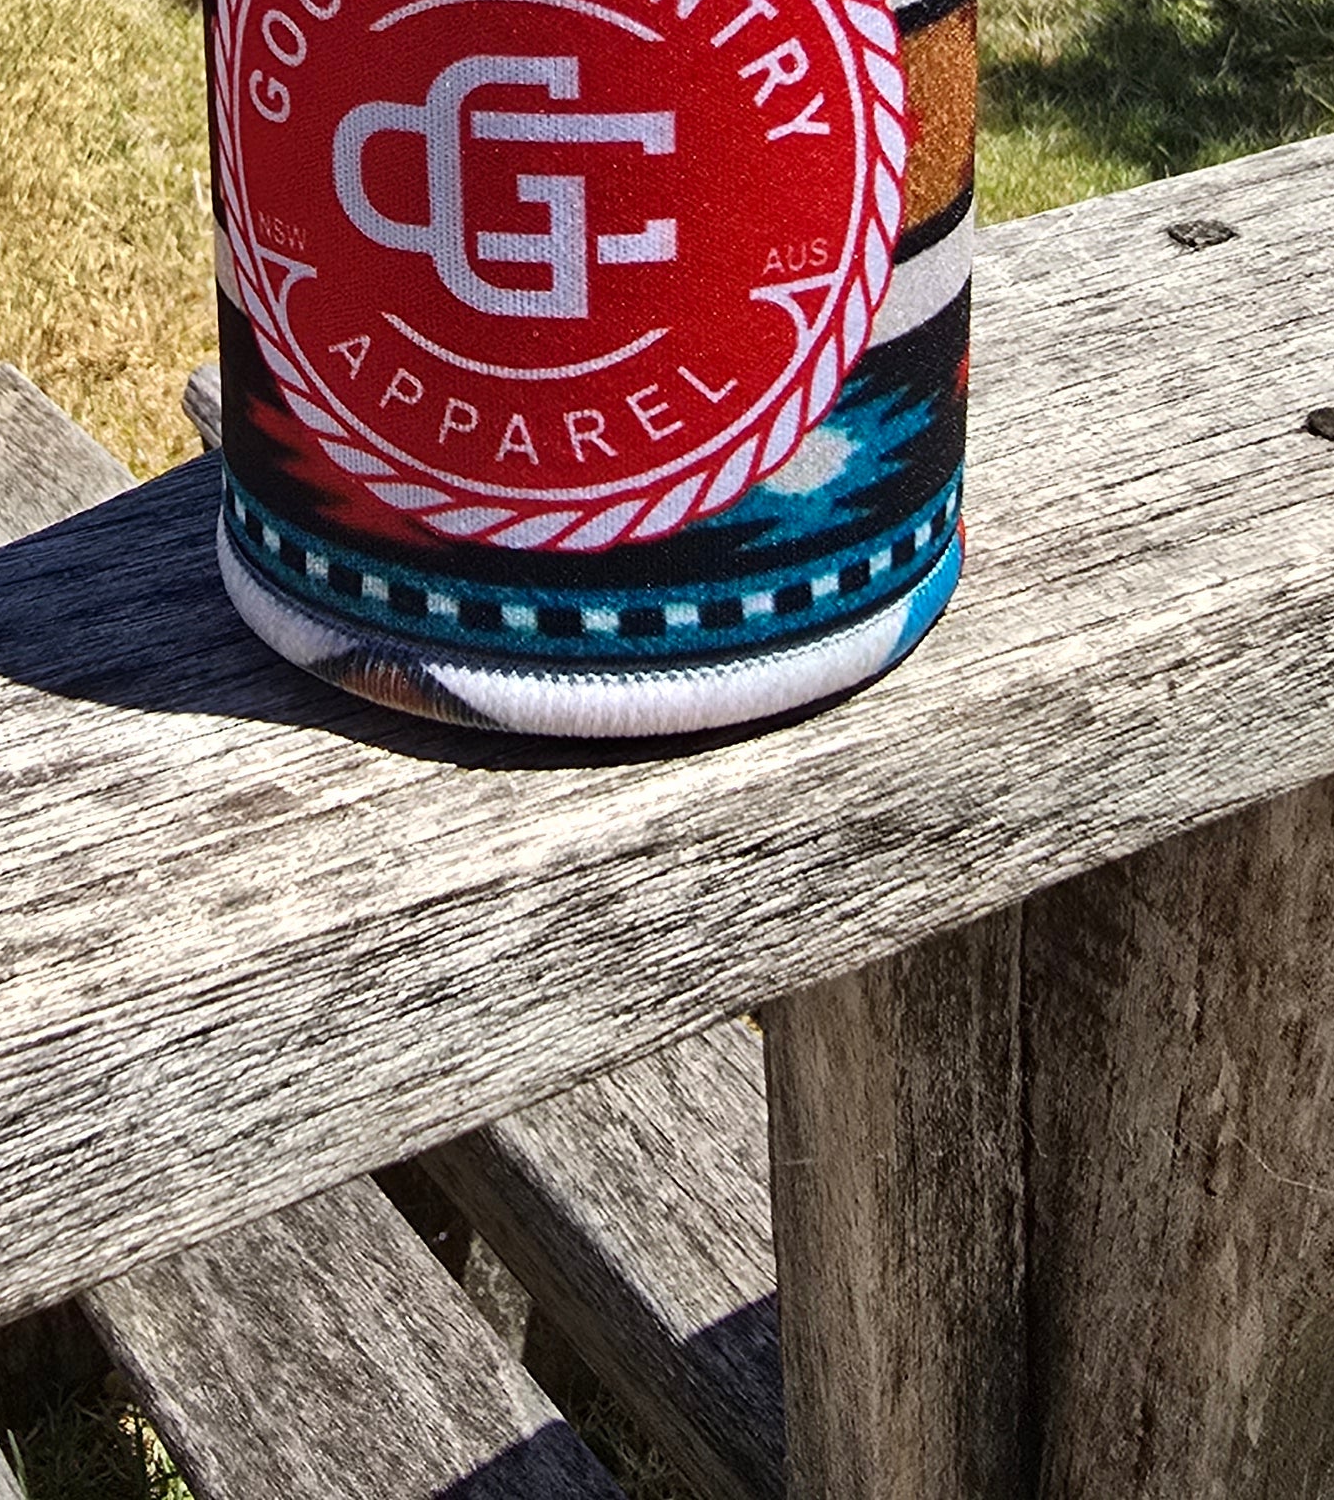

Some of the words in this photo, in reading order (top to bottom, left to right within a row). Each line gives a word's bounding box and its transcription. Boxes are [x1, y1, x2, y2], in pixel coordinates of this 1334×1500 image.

[257, 209, 307, 251] NSW
[761, 238, 829, 276] AUS
[327, 333, 738, 466] APPAREL
